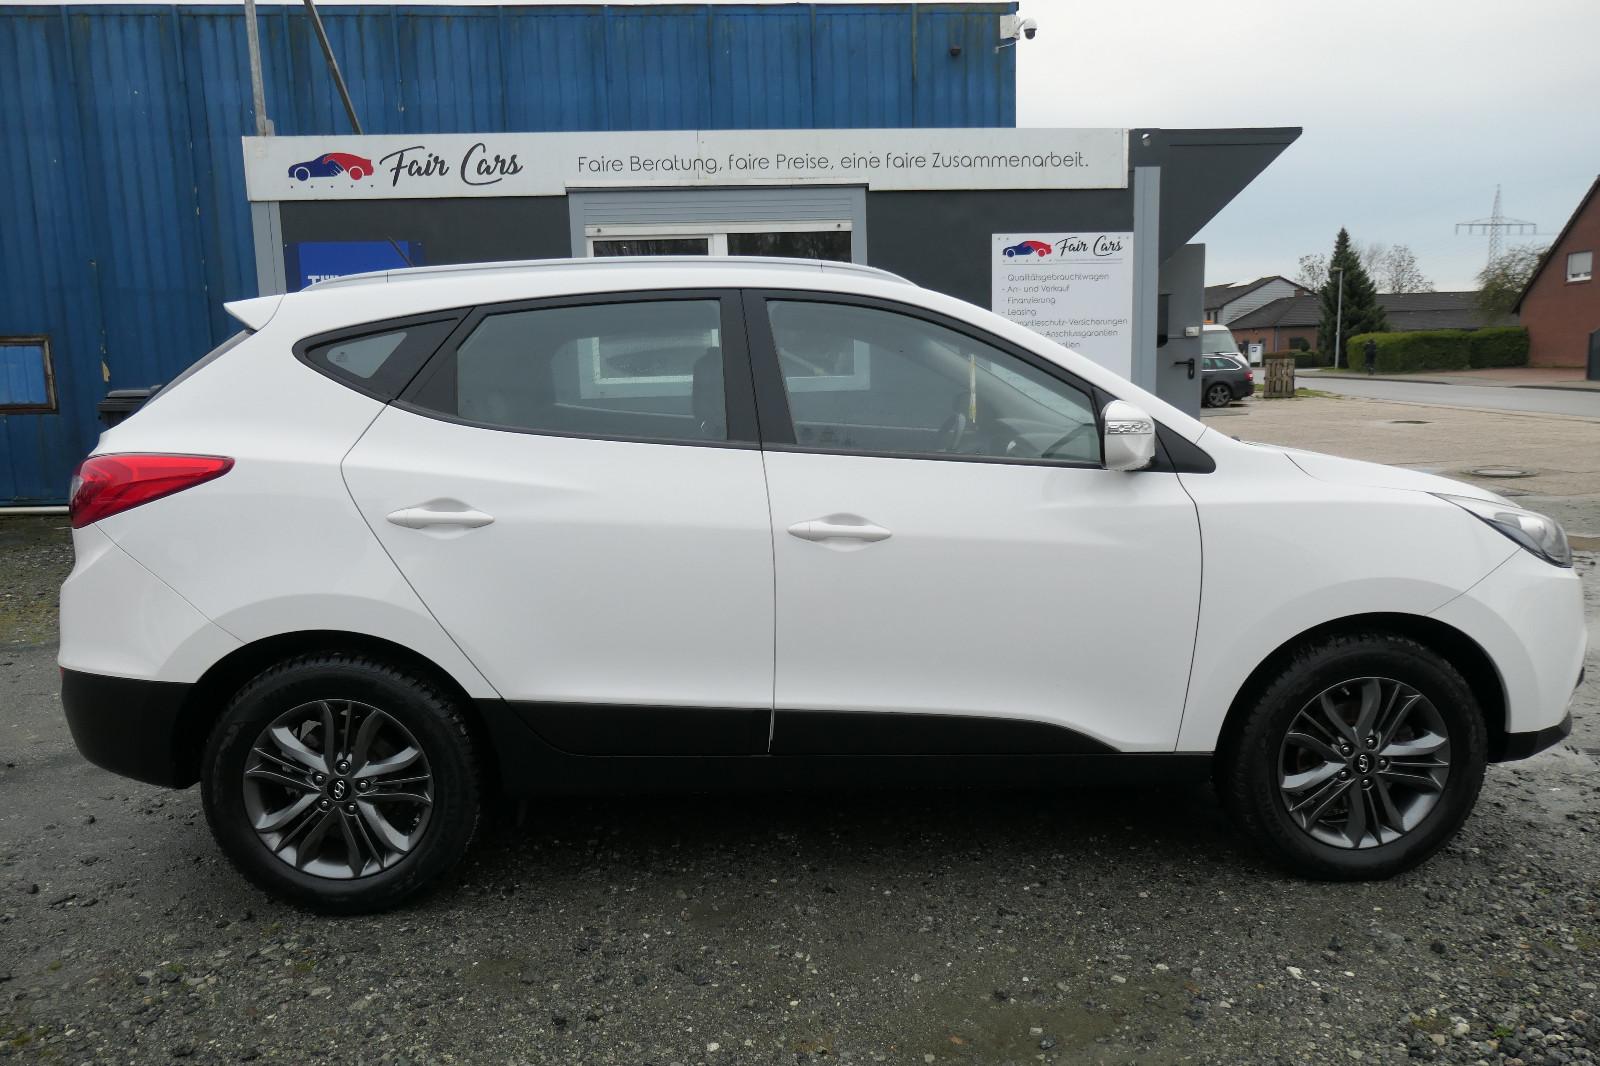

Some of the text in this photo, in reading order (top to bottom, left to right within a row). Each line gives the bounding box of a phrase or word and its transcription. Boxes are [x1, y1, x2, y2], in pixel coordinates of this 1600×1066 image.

[379, 142, 524, 187] Fair Cars
[578, 151, 1089, 179] Faire Beratung, faire Preise, eine faire Zusammenarbeit.
[1055, 235, 1123, 257] Fair Cars
[1007, 273, 1110, 283] Qualitätsgebrauchtwagen
[1024, 285, 1039, 293] und
[1042, 284, 1070, 292] Verkauf
[1007, 295, 1056, 305] Finanzierung
[1007, 308, 1037, 317] Leasing
